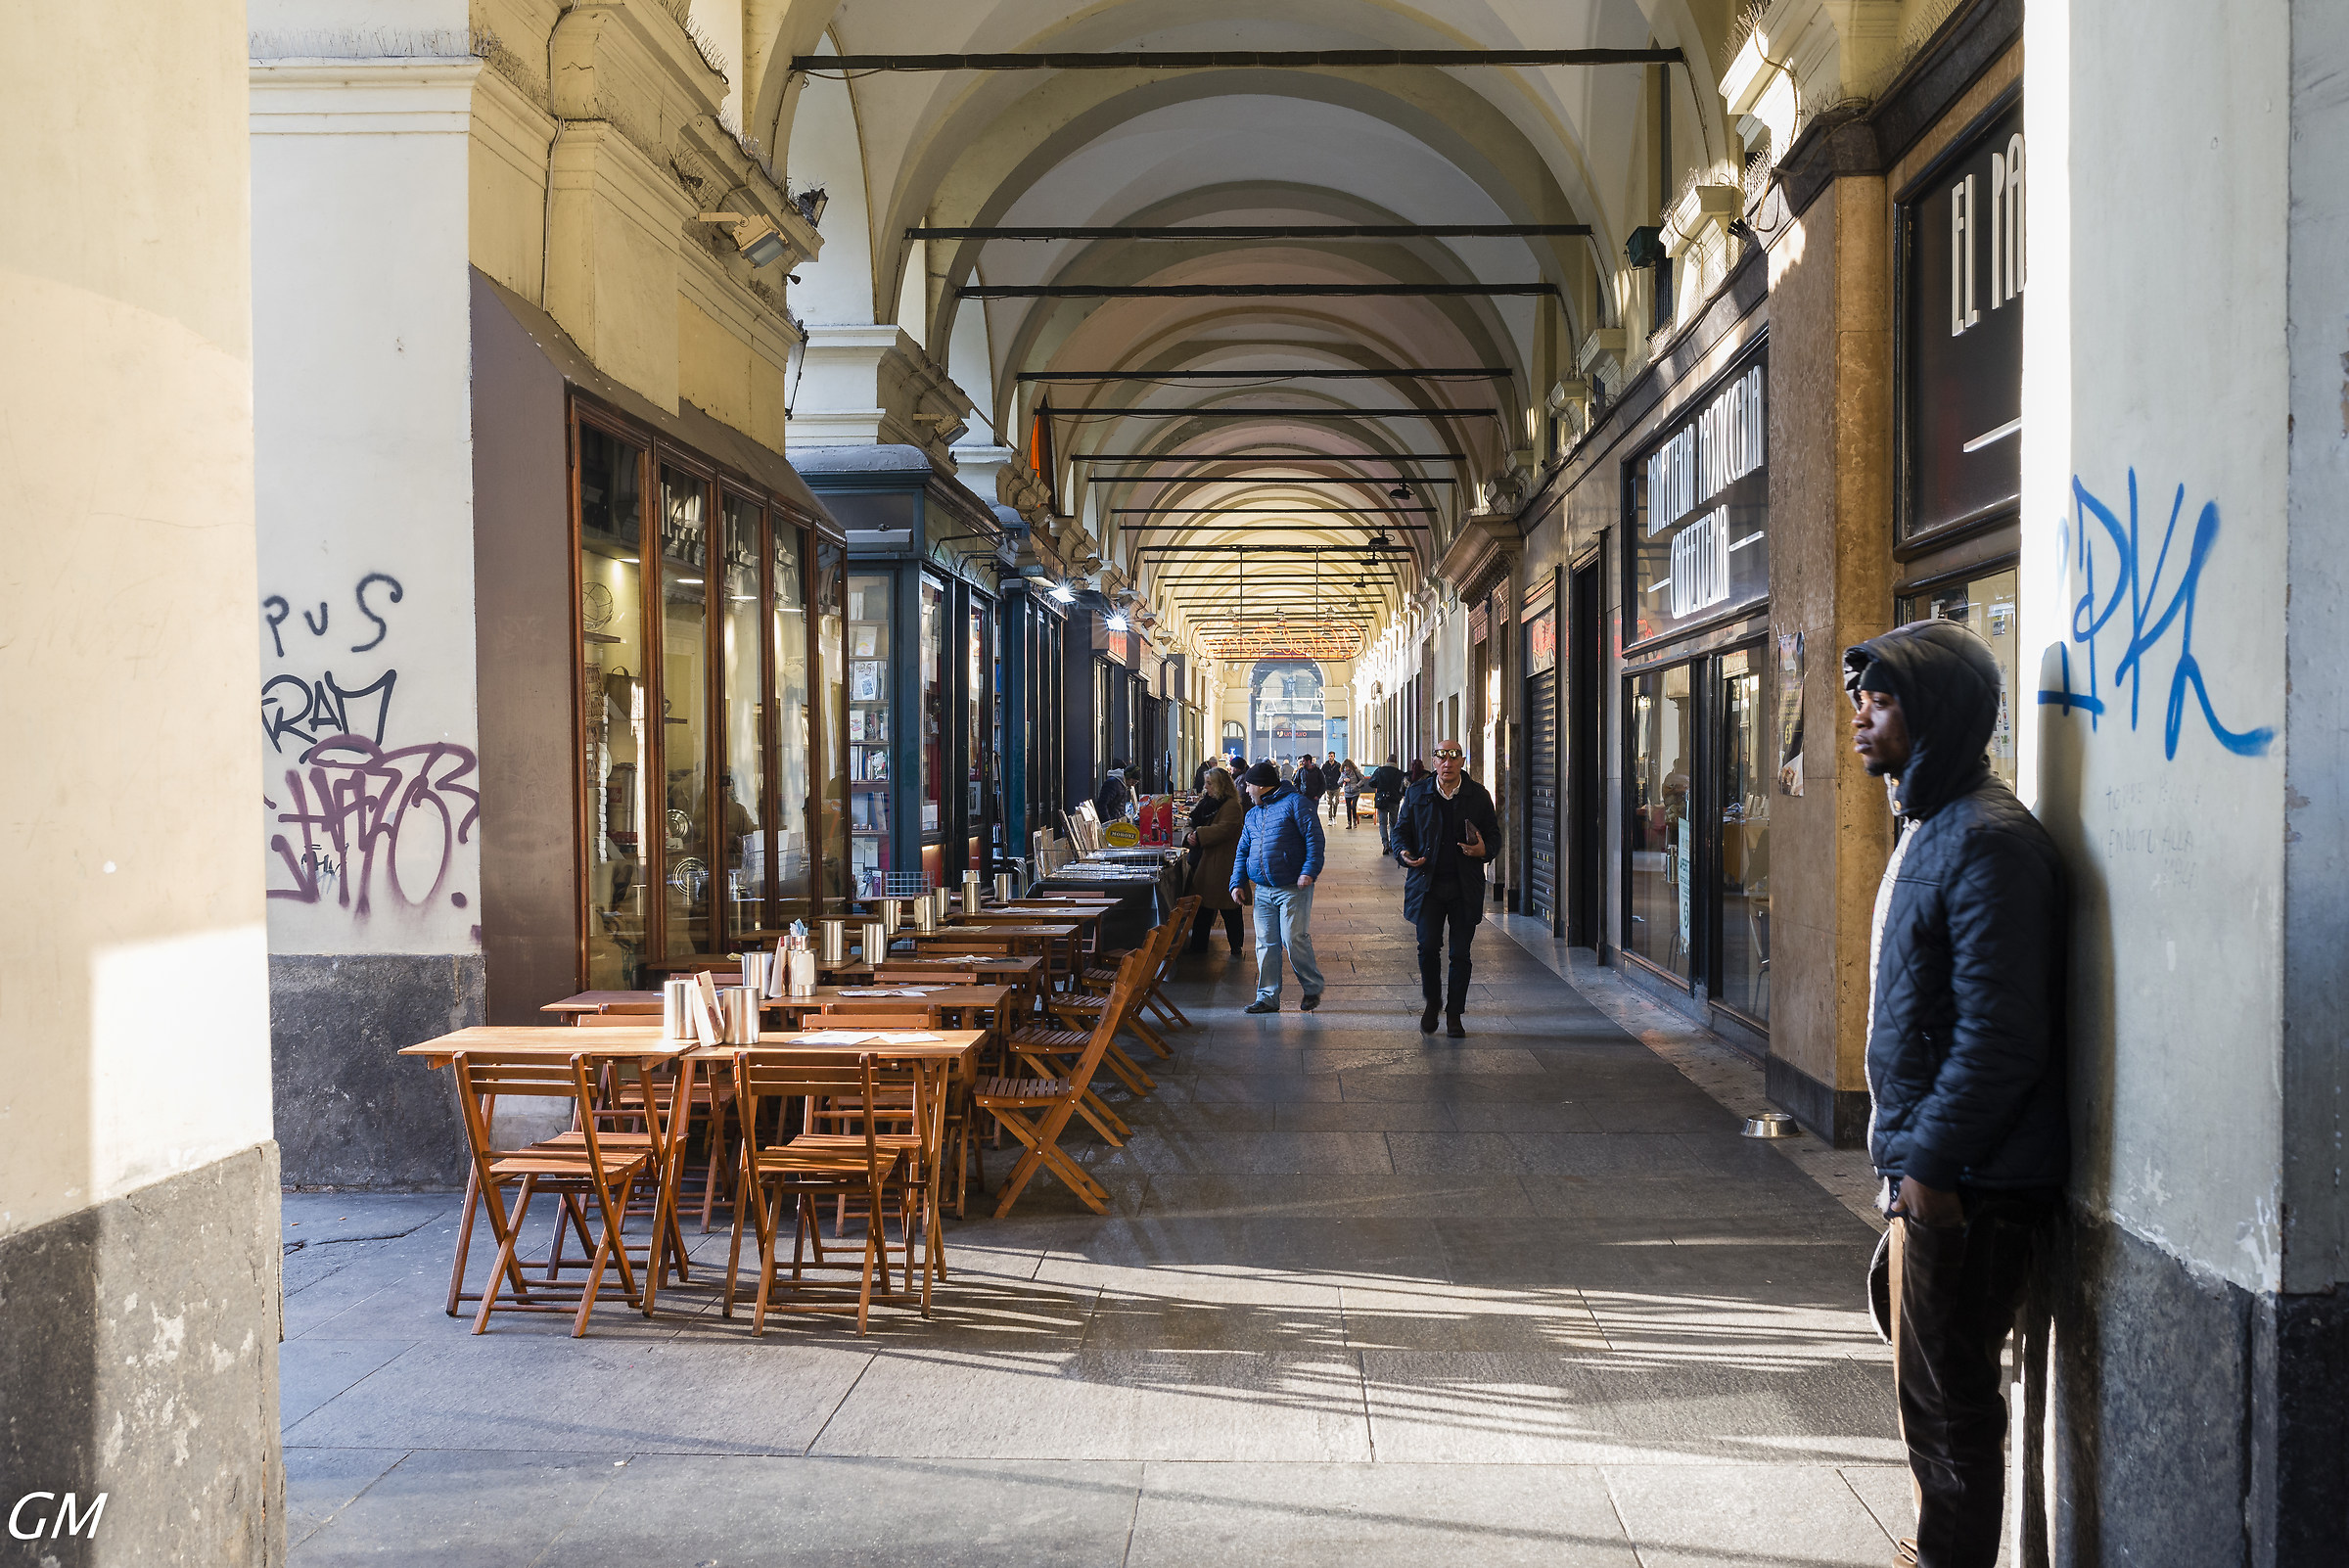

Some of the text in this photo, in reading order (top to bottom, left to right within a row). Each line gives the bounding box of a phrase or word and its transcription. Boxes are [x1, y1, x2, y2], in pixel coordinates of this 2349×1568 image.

[1951, 132, 2027, 338] EL PA
[1647, 364, 1765, 538] PANETTERIA PASTICCERIA
[1670, 503, 1730, 621] CAFFETTERIA
